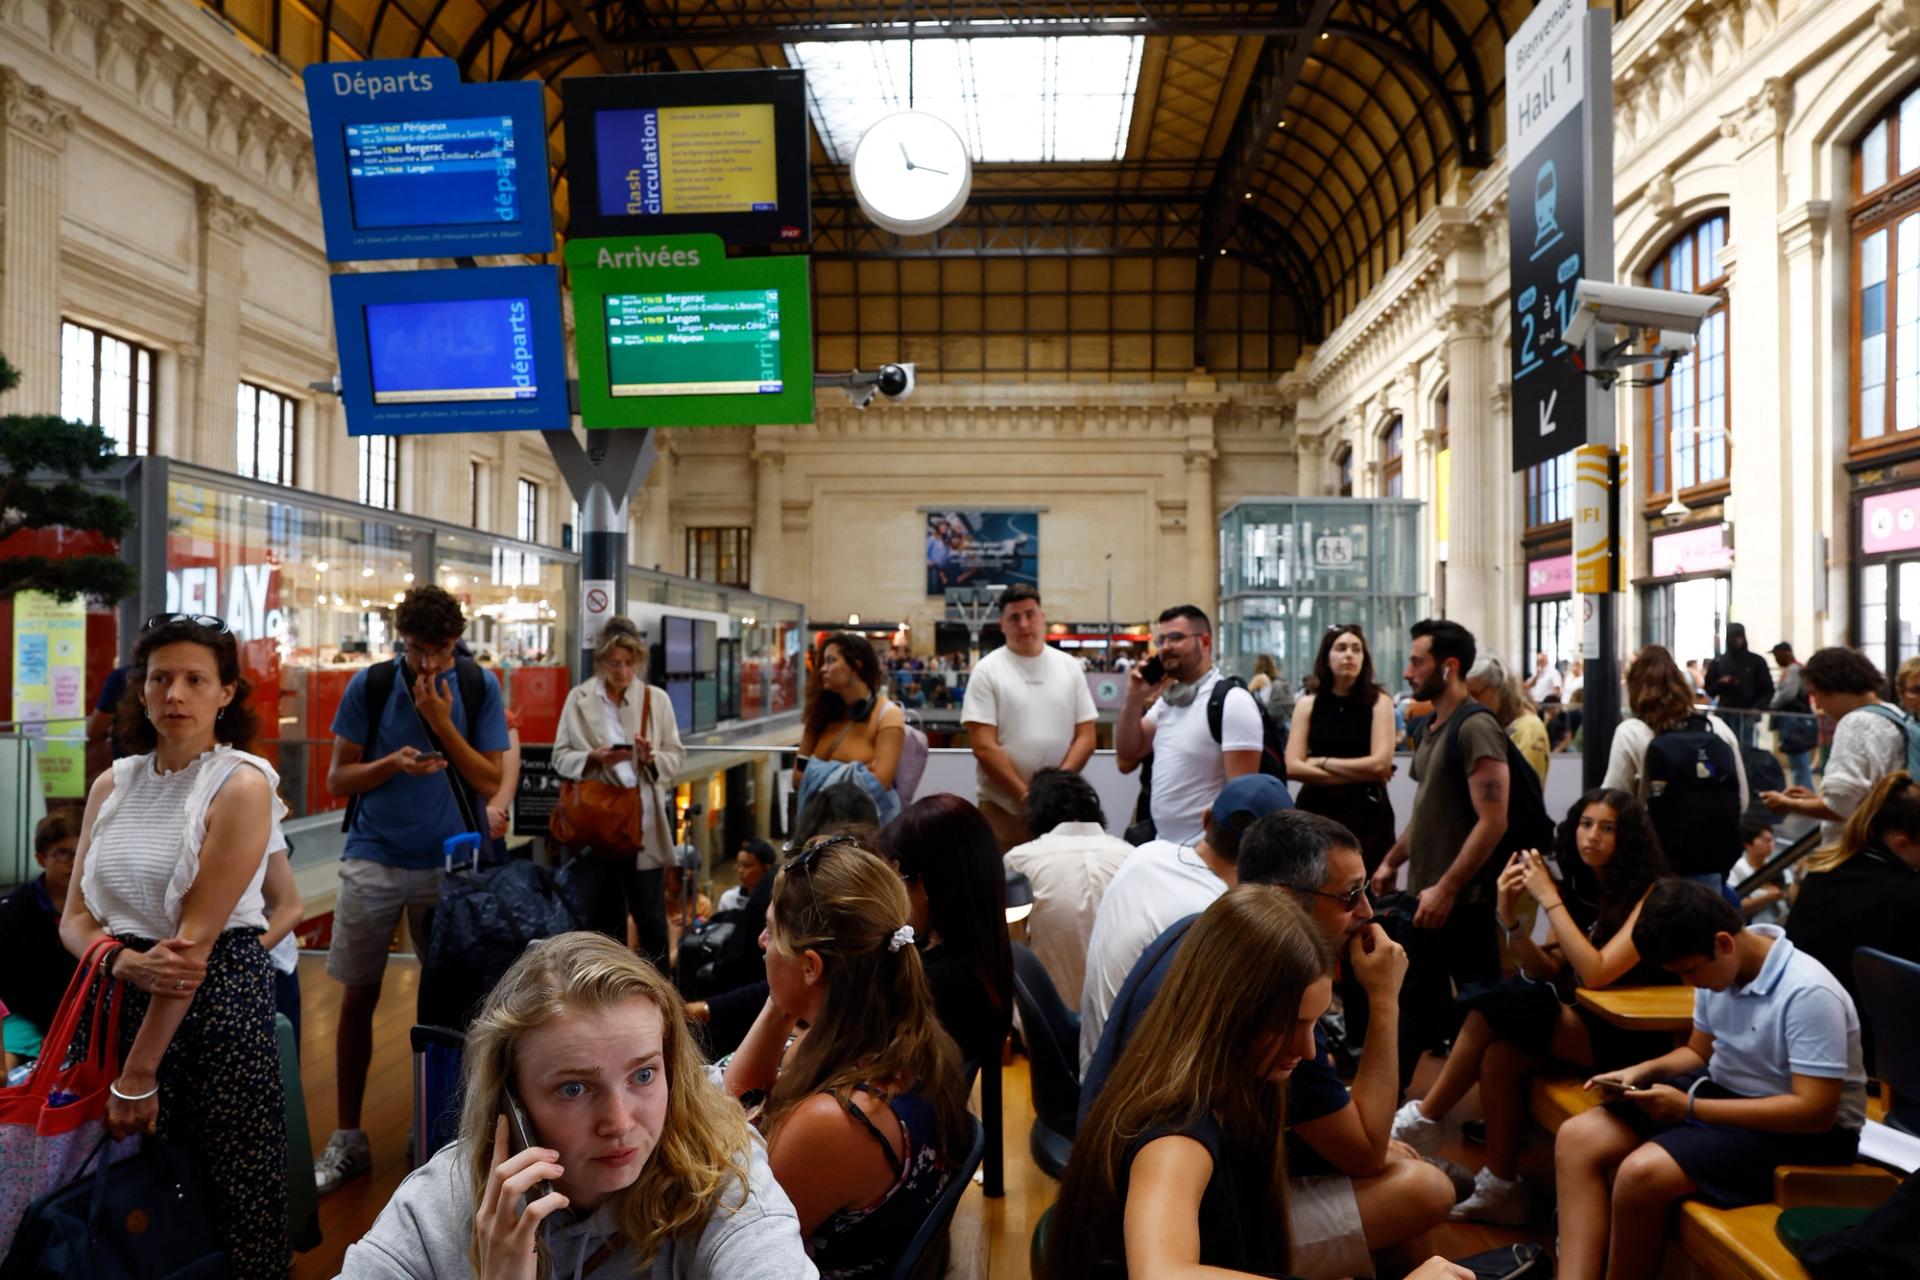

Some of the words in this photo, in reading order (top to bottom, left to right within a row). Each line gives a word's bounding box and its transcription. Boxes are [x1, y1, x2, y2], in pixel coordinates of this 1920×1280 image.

[1517, 0, 1573, 71] Bienvenue
[332, 71, 433, 99] Départs
[1518, 66, 1555, 137] Hall
[1562, 45, 1573, 86] 1
[403, 122, 446, 135] Périgueux
[405, 143, 444, 156] Bergerac
[641, 113, 661, 214] circulation
[626, 169, 642, 214] flash
[596, 246, 700, 269] Arrivées
[666, 293, 705, 305] Bergerac
[667, 313, 700, 326] Langon
[509, 301, 532, 387] départs
[1521, 313, 1536, 366] 2
[1578, 507, 1600, 523] IFI
